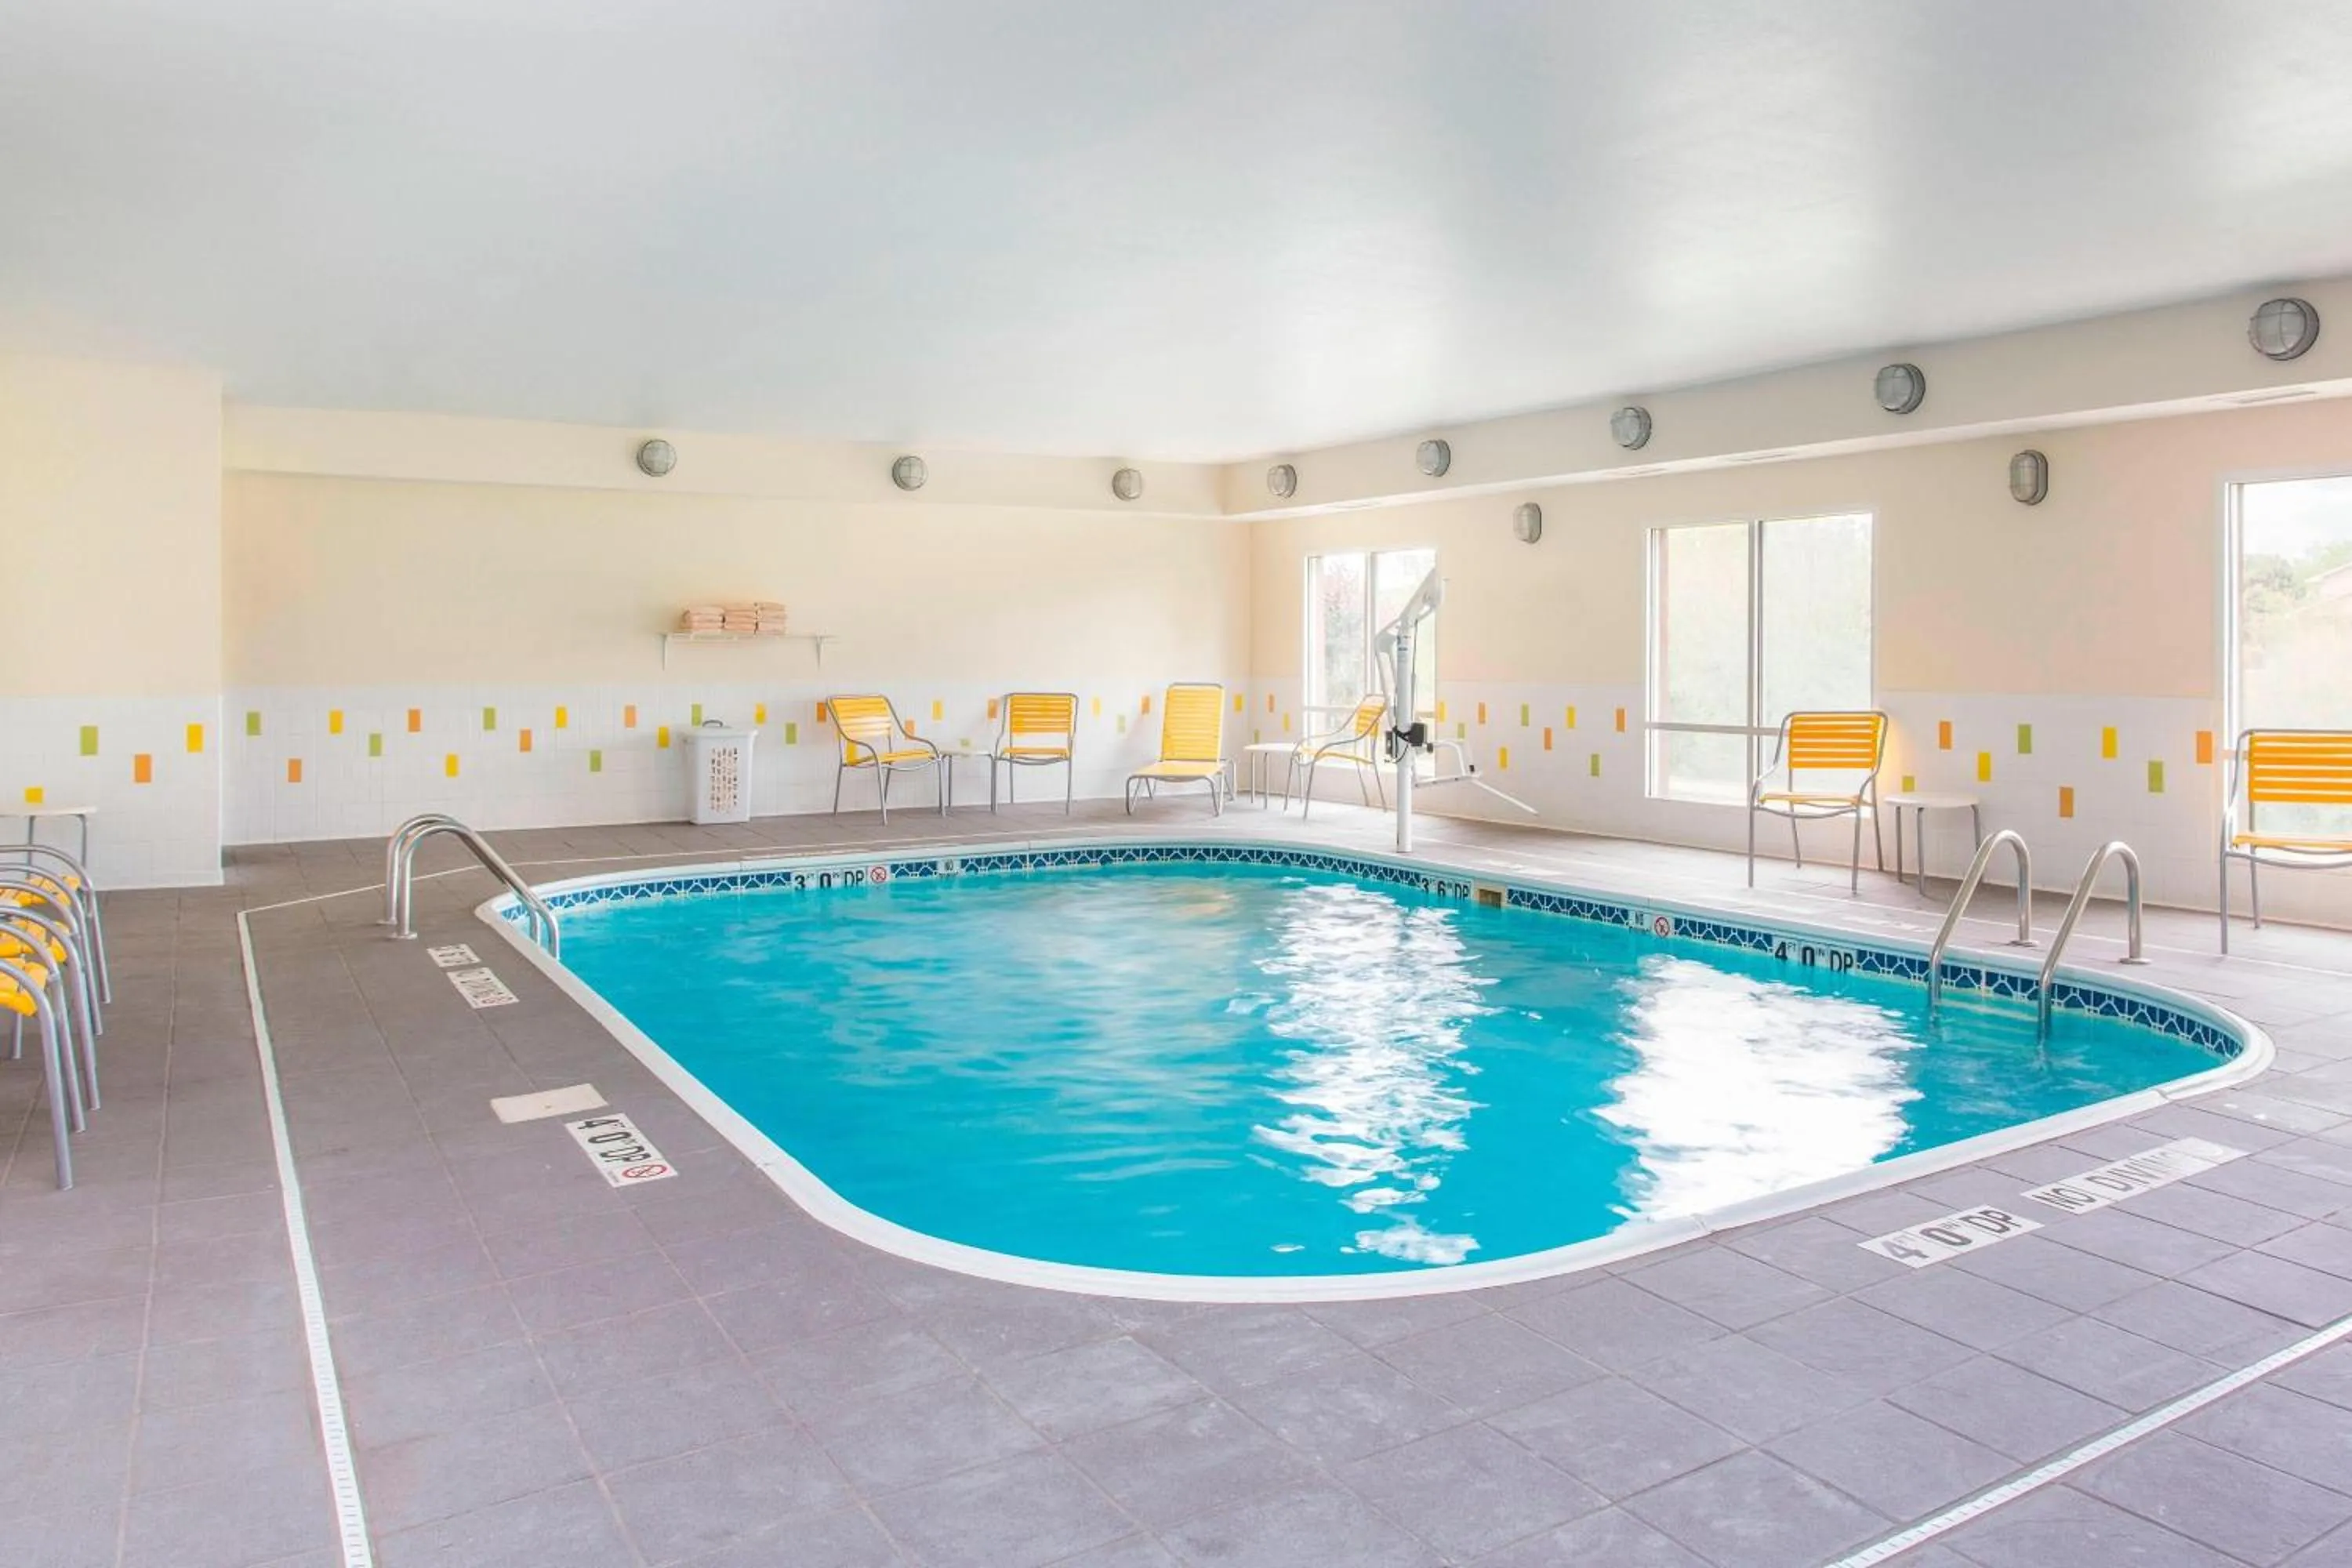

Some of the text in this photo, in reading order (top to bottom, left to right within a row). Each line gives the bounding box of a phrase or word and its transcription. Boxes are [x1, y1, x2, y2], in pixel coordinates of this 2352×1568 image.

[794, 874, 806, 891] 3
[844, 869, 865, 888] DP
[1421, 877, 1469, 902] 3 6 DP
[1774, 942, 1788, 960] 4
[1831, 949, 1854, 974] DP
[577, 1119, 652, 1163] 4 0 DP
[2031, 1187, 2096, 1210] NO
[1883, 1240, 1930, 1260] 4
[1919, 1226, 1973, 1247] 0
[1959, 1209, 2022, 1234] DP
